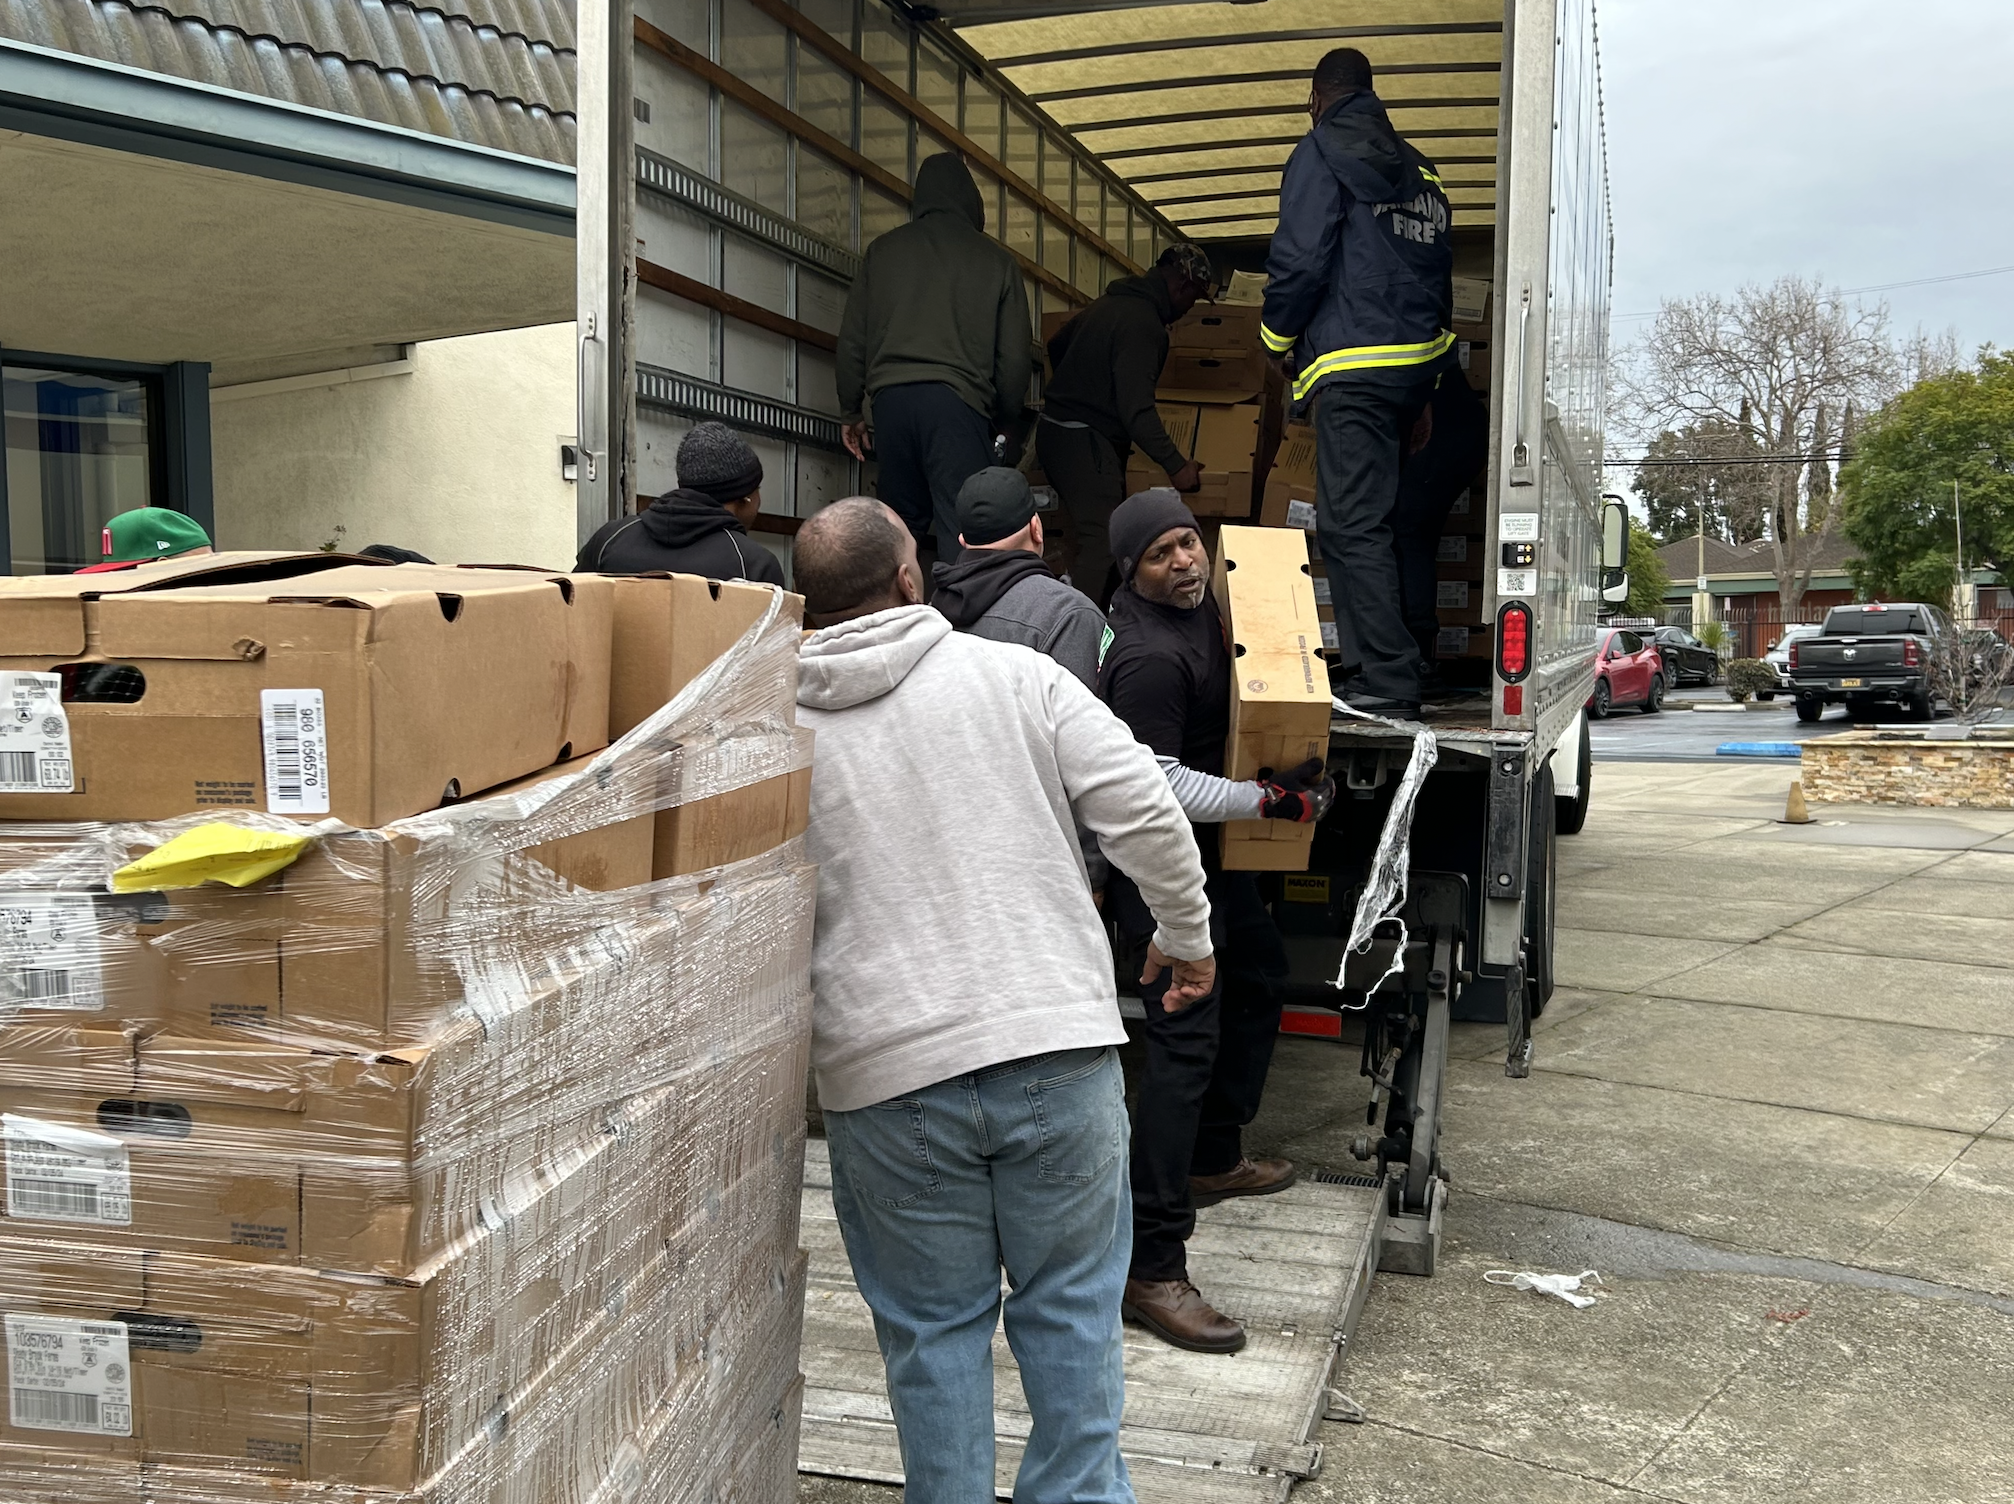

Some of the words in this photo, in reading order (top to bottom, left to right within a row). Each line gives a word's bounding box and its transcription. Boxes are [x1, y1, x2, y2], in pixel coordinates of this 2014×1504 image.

[1392, 212, 1436, 245] FIRE
[301, 708, 315, 733] 980
[302, 740, 318, 787] 656570
[1287, 878, 1326, 888] MAXON
[14, 1332, 64, 1350] 103576794
